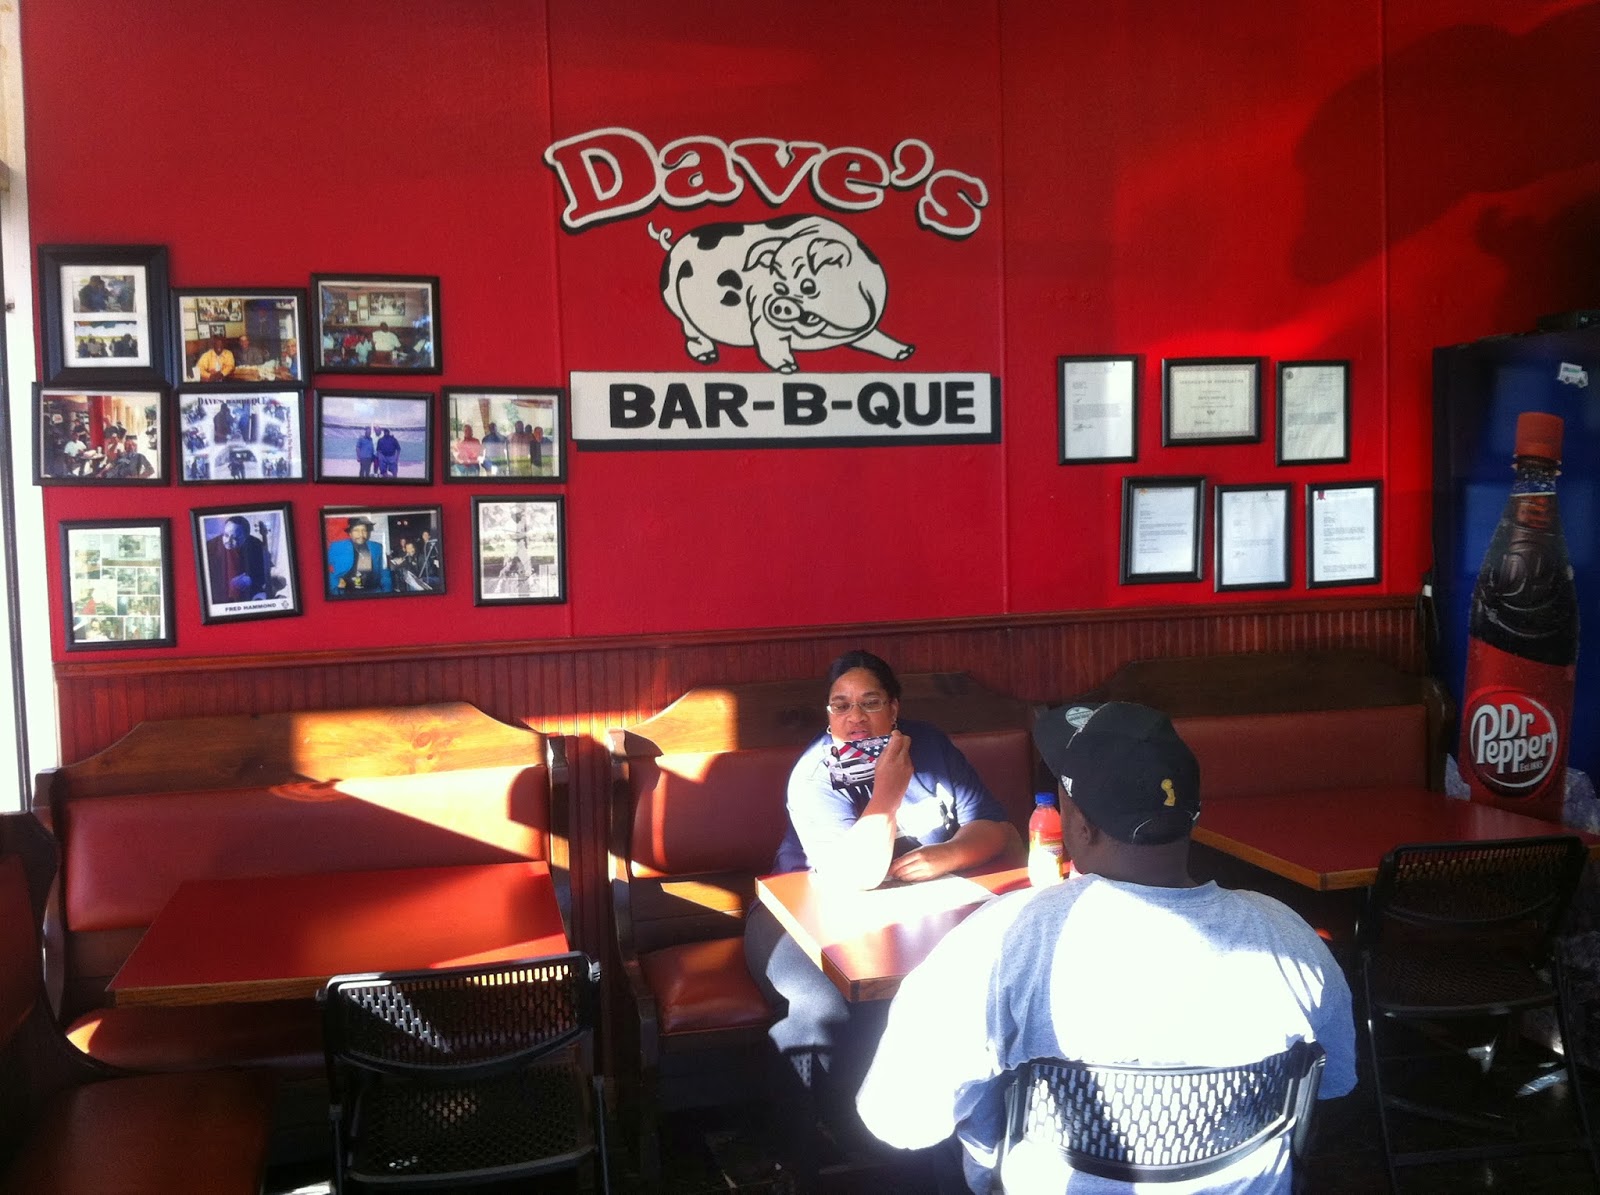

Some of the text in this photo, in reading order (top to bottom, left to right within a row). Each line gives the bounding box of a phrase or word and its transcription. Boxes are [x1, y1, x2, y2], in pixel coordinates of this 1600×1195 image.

[543, 127, 988, 241] Dave's
[609, 382, 976, 429] BAR-B-QUE
[243, 603, 277, 611] HAMMOND
[1470, 704, 1554, 774] Pepper
[1499, 703, 1535, 739] Dr
